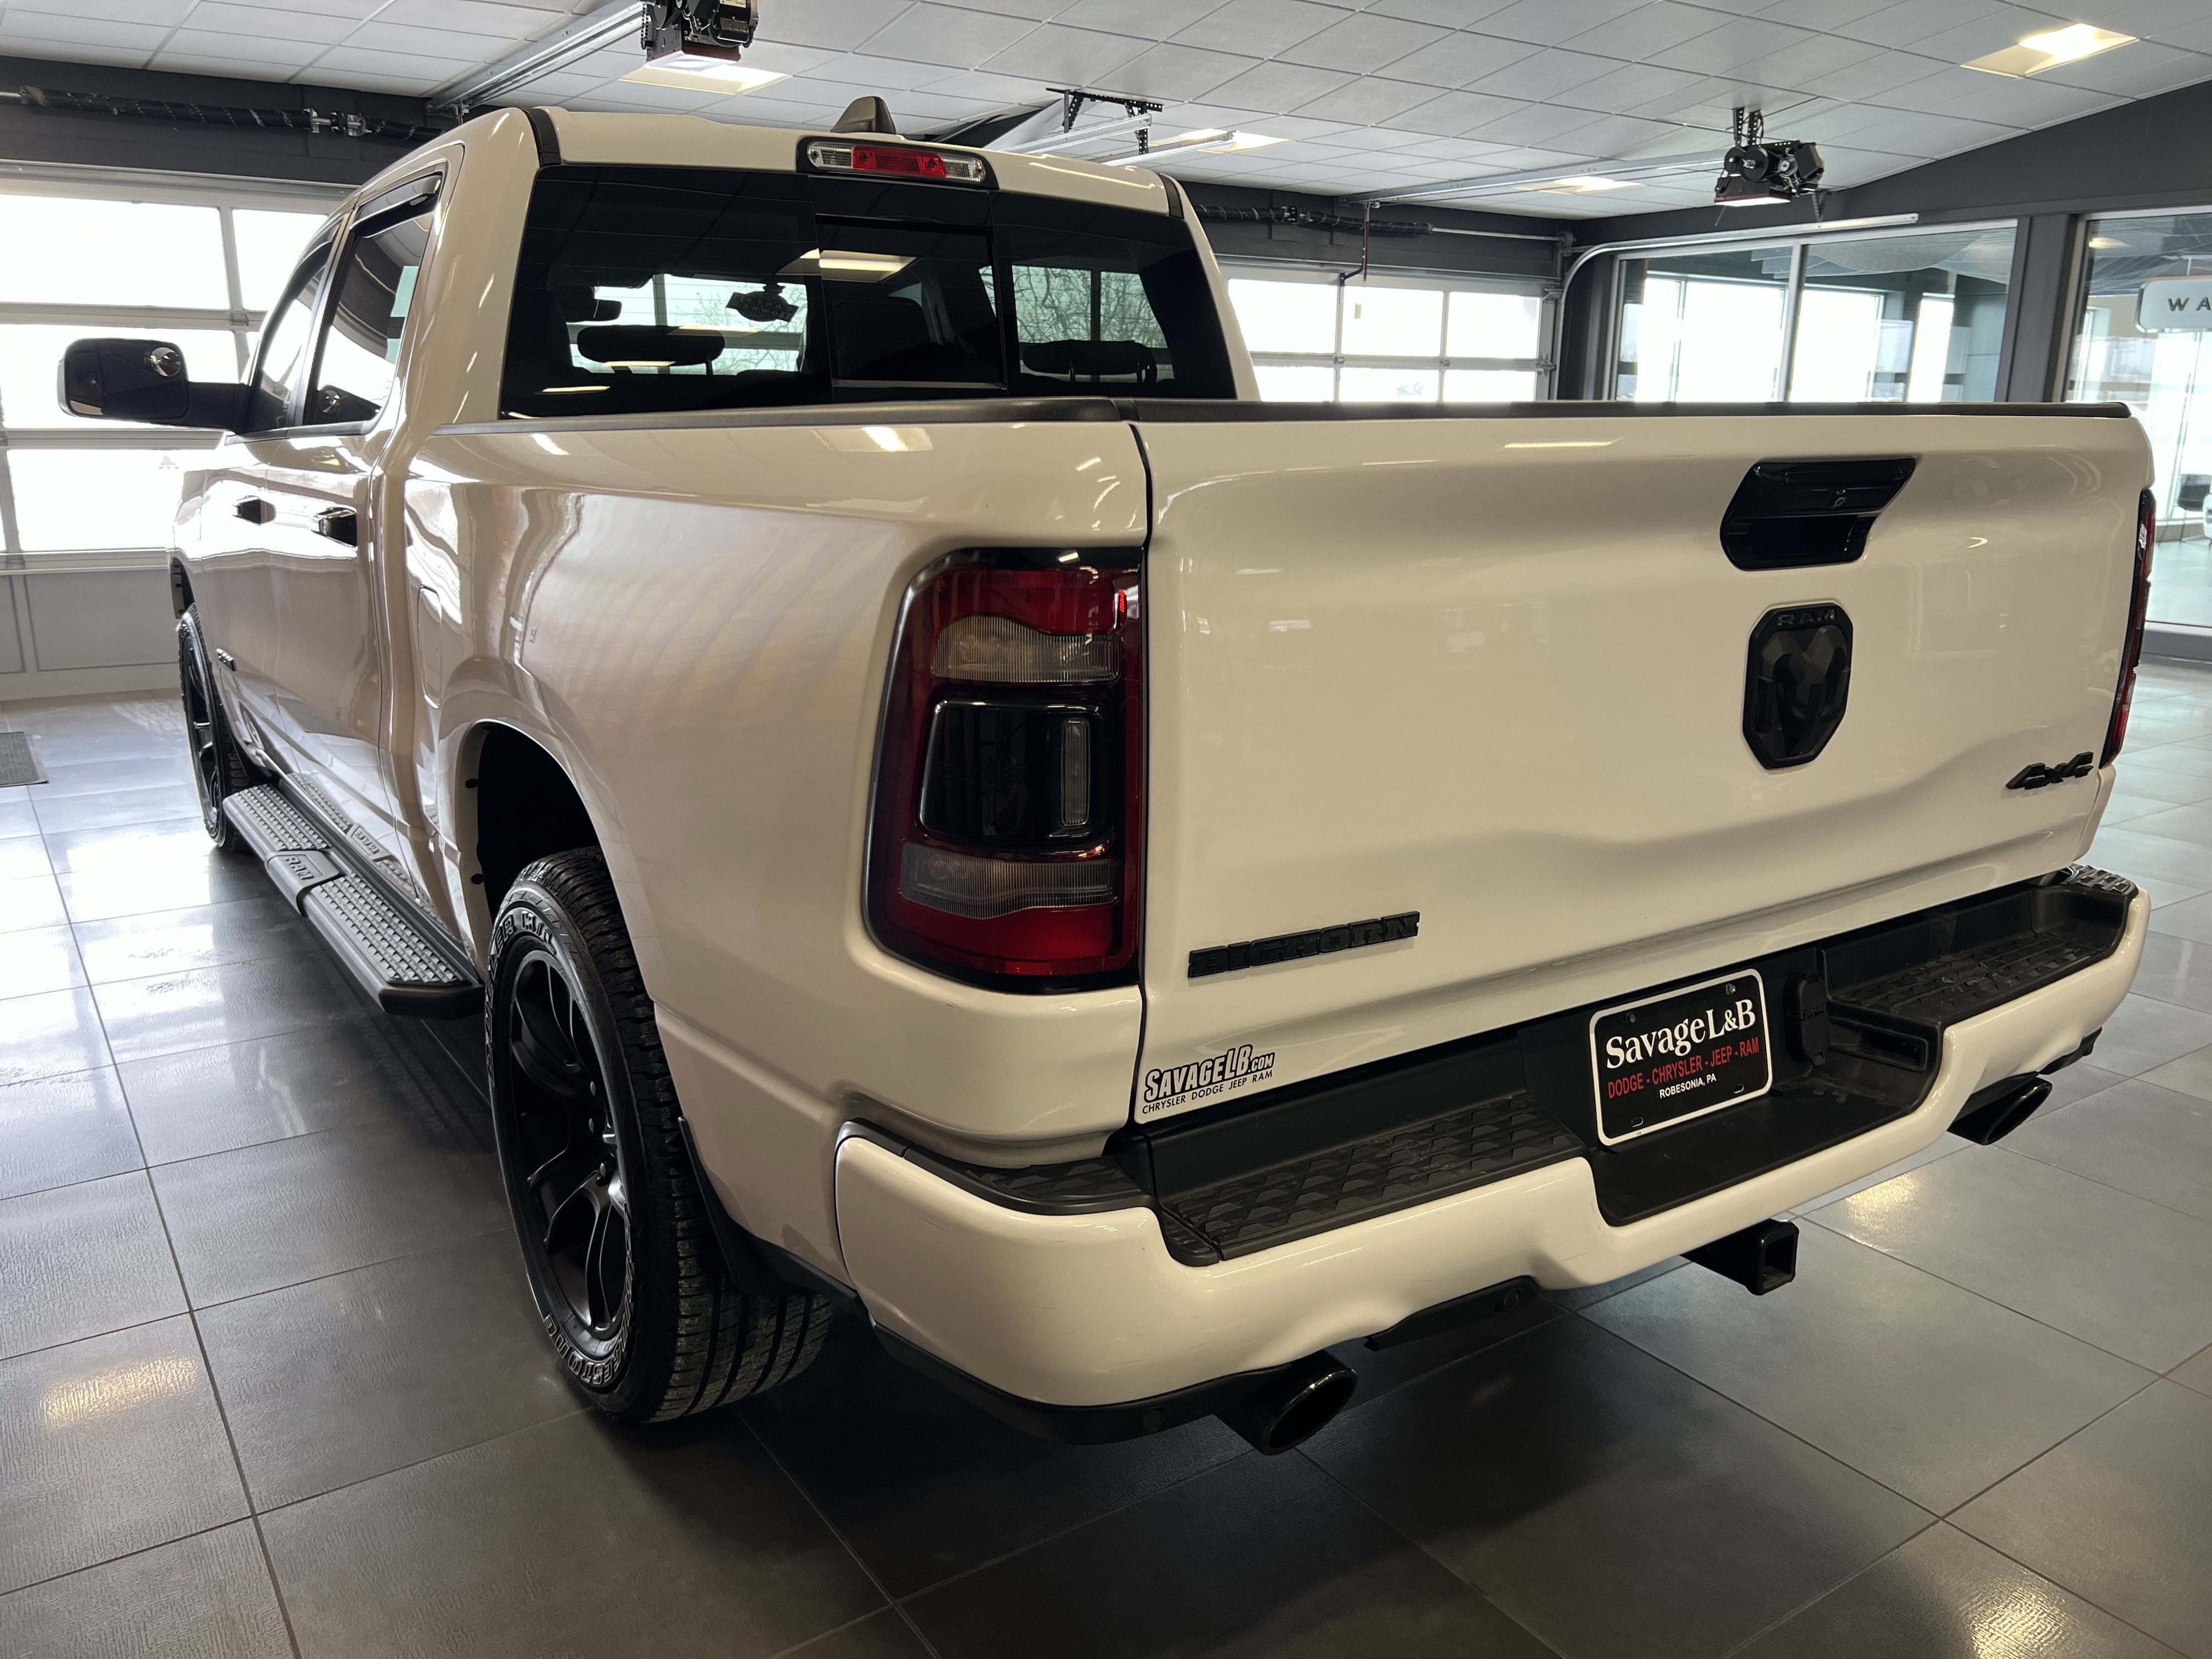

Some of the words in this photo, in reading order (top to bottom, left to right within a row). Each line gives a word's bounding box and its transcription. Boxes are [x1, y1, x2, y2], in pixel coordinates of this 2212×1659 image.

[1778, 608, 1836, 626] RAM
[285, 856, 314, 880] RAM
[1607, 1073, 1644, 1098] DODGE
[1652, 1054, 1703, 1085] CHRYSLER
[1710, 1045, 1733, 1067] JEEP
[1739, 1036, 1759, 1057] RAM
[1142, 1095, 1186, 1114] CHRYSLER
[1192, 1084, 1224, 1100] DODGE
[1229, 1077, 1247, 1090] JEEP
[1252, 1070, 1272, 1083] RAM
[1660, 1079, 1705, 1098] ROBESONIA,
[1707, 1073, 1717, 1083] PA
